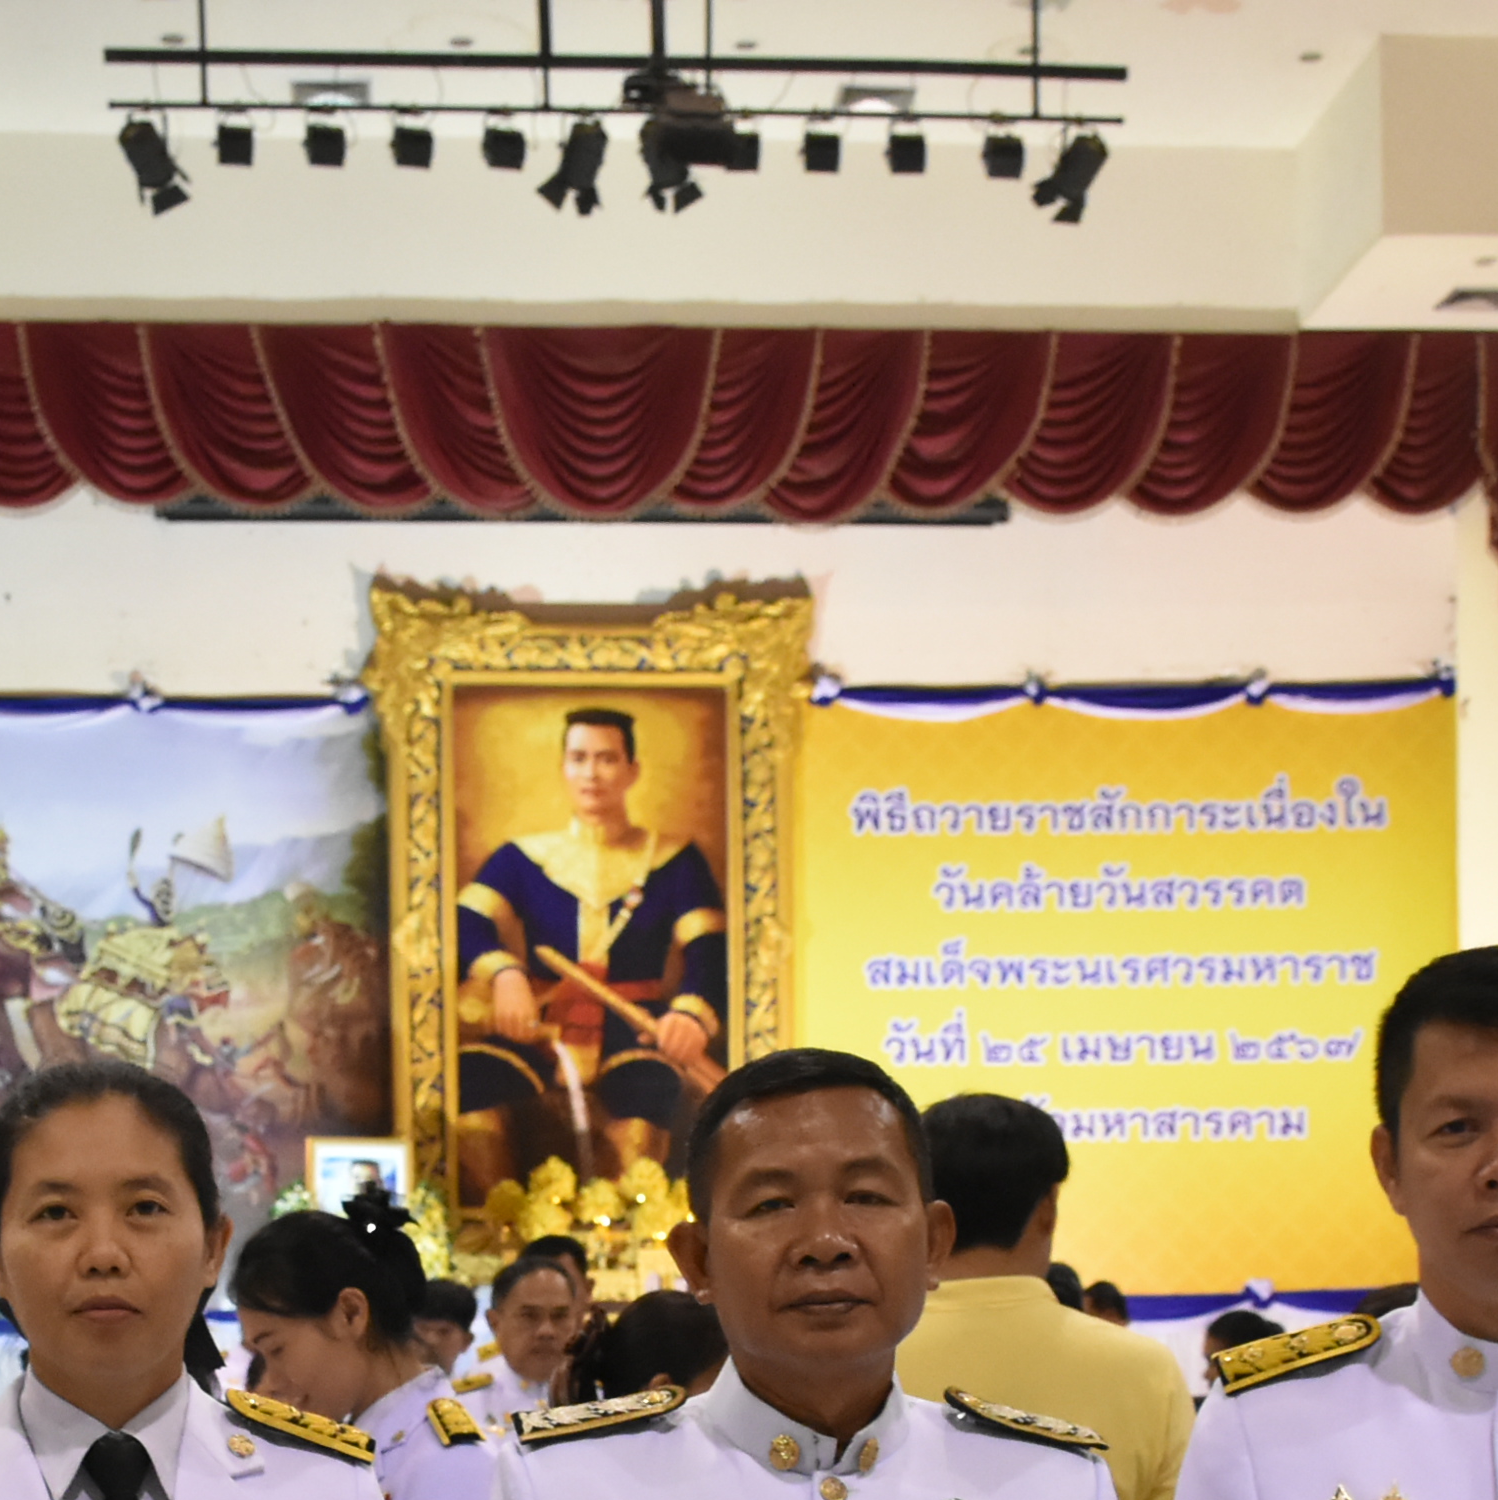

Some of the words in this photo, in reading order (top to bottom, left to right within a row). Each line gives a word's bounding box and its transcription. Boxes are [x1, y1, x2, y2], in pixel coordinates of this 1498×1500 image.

[850, 776, 1387, 832] พิธีถวายราชสักการะเนื่องใน
[932, 865, 1306, 909] วันคล้ายวันสวรรคต
[865, 938, 1377, 987] สมเด็จพระนเรศวรมหาราช
[884, 1009, 967, 1063] วันที่
[980, 1034, 1048, 1063] ๒๕
[1060, 1034, 1215, 1063] เมษายน
